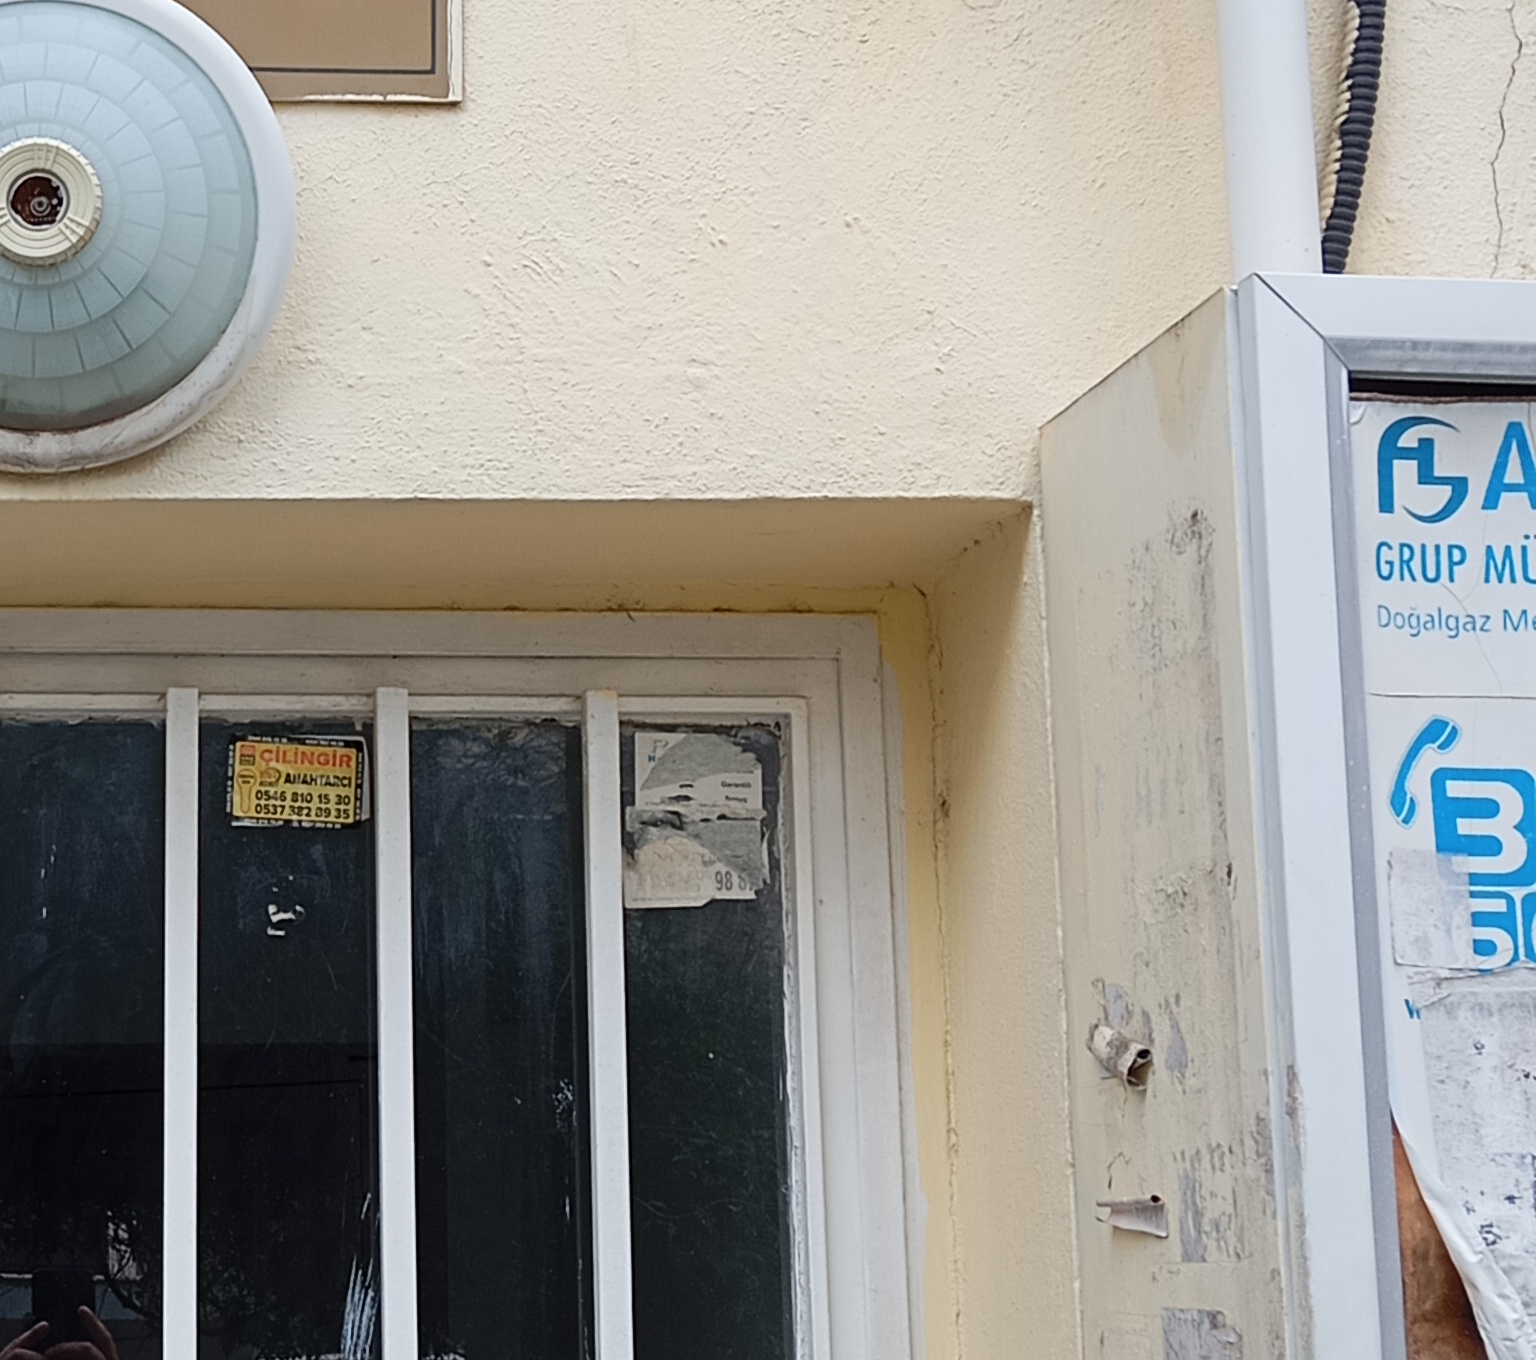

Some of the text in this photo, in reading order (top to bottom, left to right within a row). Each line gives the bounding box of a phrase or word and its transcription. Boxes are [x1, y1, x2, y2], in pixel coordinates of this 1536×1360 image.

[1375, 541, 1468, 584] GRUP
[1377, 604, 1492, 639] Doğalgaz
[259, 746, 353, 768] ÇİLİNGİR
[255, 789, 351, 806] 0546 810 15 30
[254, 802, 286, 816] 0537
[288, 805, 312, 817] 382
[334, 807, 351, 820] 35
[714, 869, 733, 892] 98
